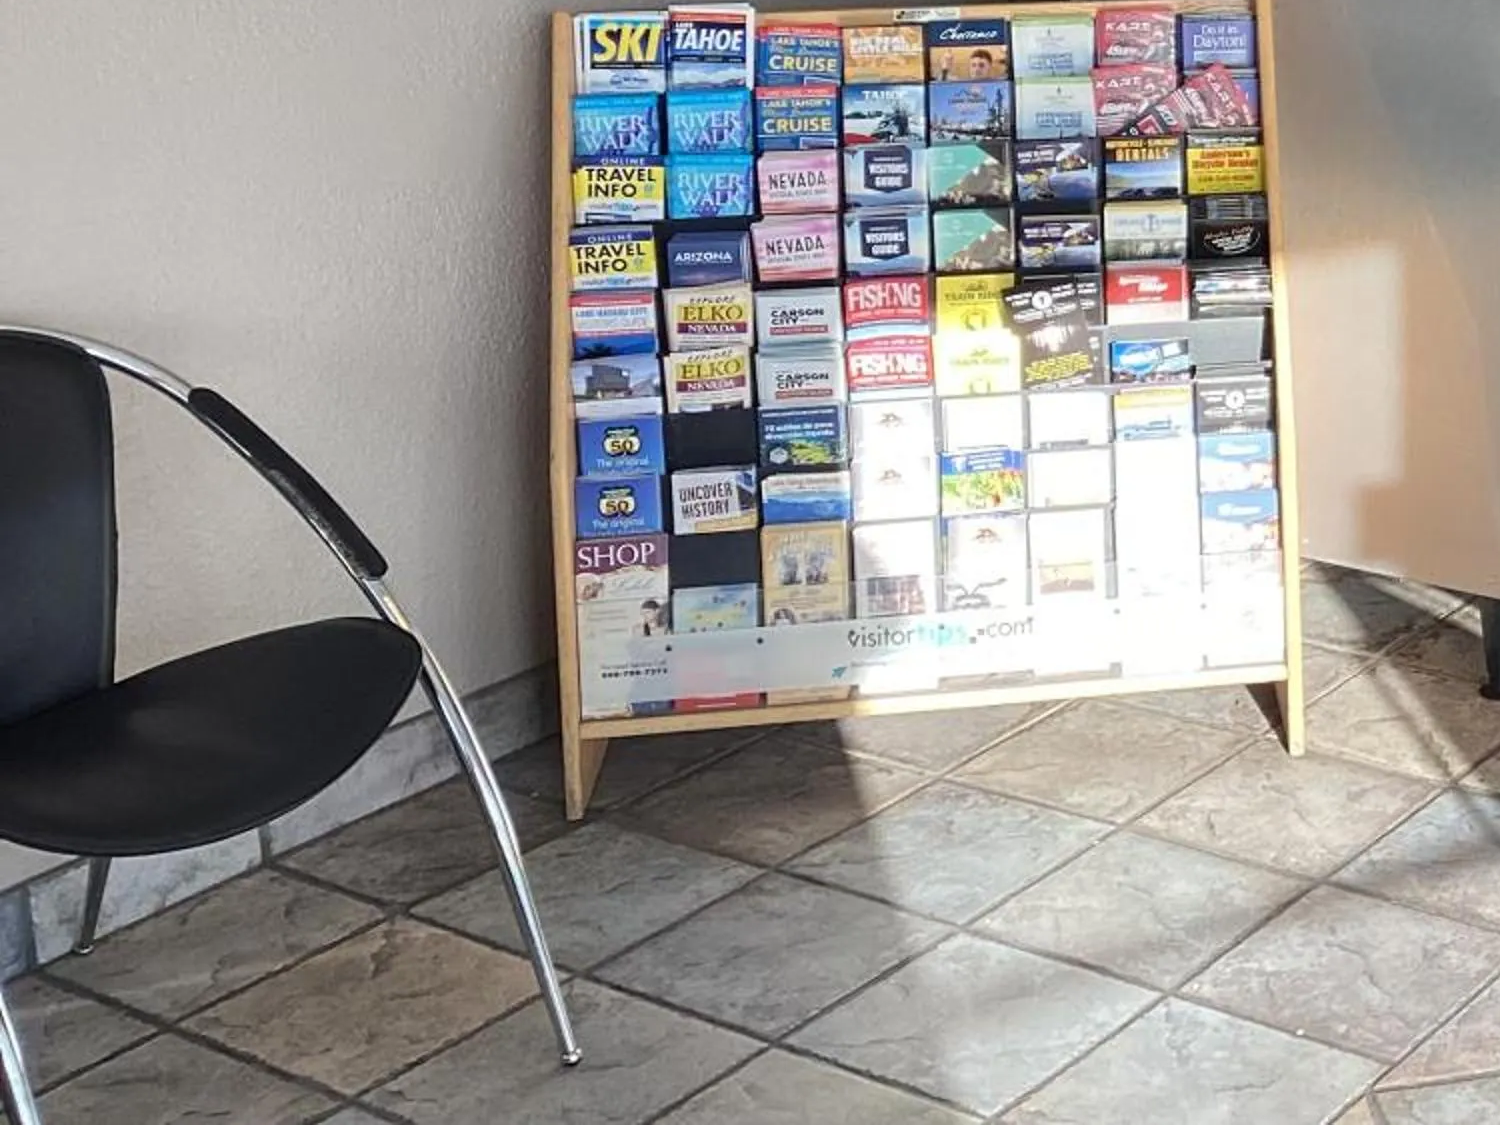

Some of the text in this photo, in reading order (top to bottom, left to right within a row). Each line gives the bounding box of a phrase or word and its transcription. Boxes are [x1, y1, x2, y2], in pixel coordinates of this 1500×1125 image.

[593, 23, 662, 63] SKI
[673, 28, 744, 52] TAHOE
[769, 55, 837, 72] CRUISE
[578, 115, 647, 134] RIVER
[673, 110, 743, 131] RIVER
[763, 116, 833, 134] CRUISE
[582, 131, 650, 154] WALK
[676, 127, 743, 151] WALK
[600, 157, 646, 166] ONLINE
[585, 168, 656, 182] TRAVEL
[677, 171, 745, 192] RIVER
[769, 170, 827, 190] NEVADA
[588, 182, 637, 198] INFO
[679, 189, 745, 211] WALK
[587, 233, 633, 244] ONLINE
[765, 234, 825, 256] NEVADA
[574, 242, 647, 260] TRAVEL
[674, 251, 734, 262] ARIZONA
[577, 258, 628, 274] INFO
[846, 282, 922, 311] FISHING
[682, 304, 743, 322] ELKO
[771, 308, 824, 318] CARSON
[688, 324, 737, 332] NEVADA
[681, 358, 741, 380] ELKO
[775, 373, 830, 382] CARSON
[687, 379, 735, 391] NEVADA
[777, 382, 804, 390] CITY
[611, 439, 634, 452] 50
[679, 482, 734, 502] UNCOVER
[605, 500, 629, 513] 50
[681, 499, 730, 519] HISTORY
[577, 542, 655, 569] SHOP
